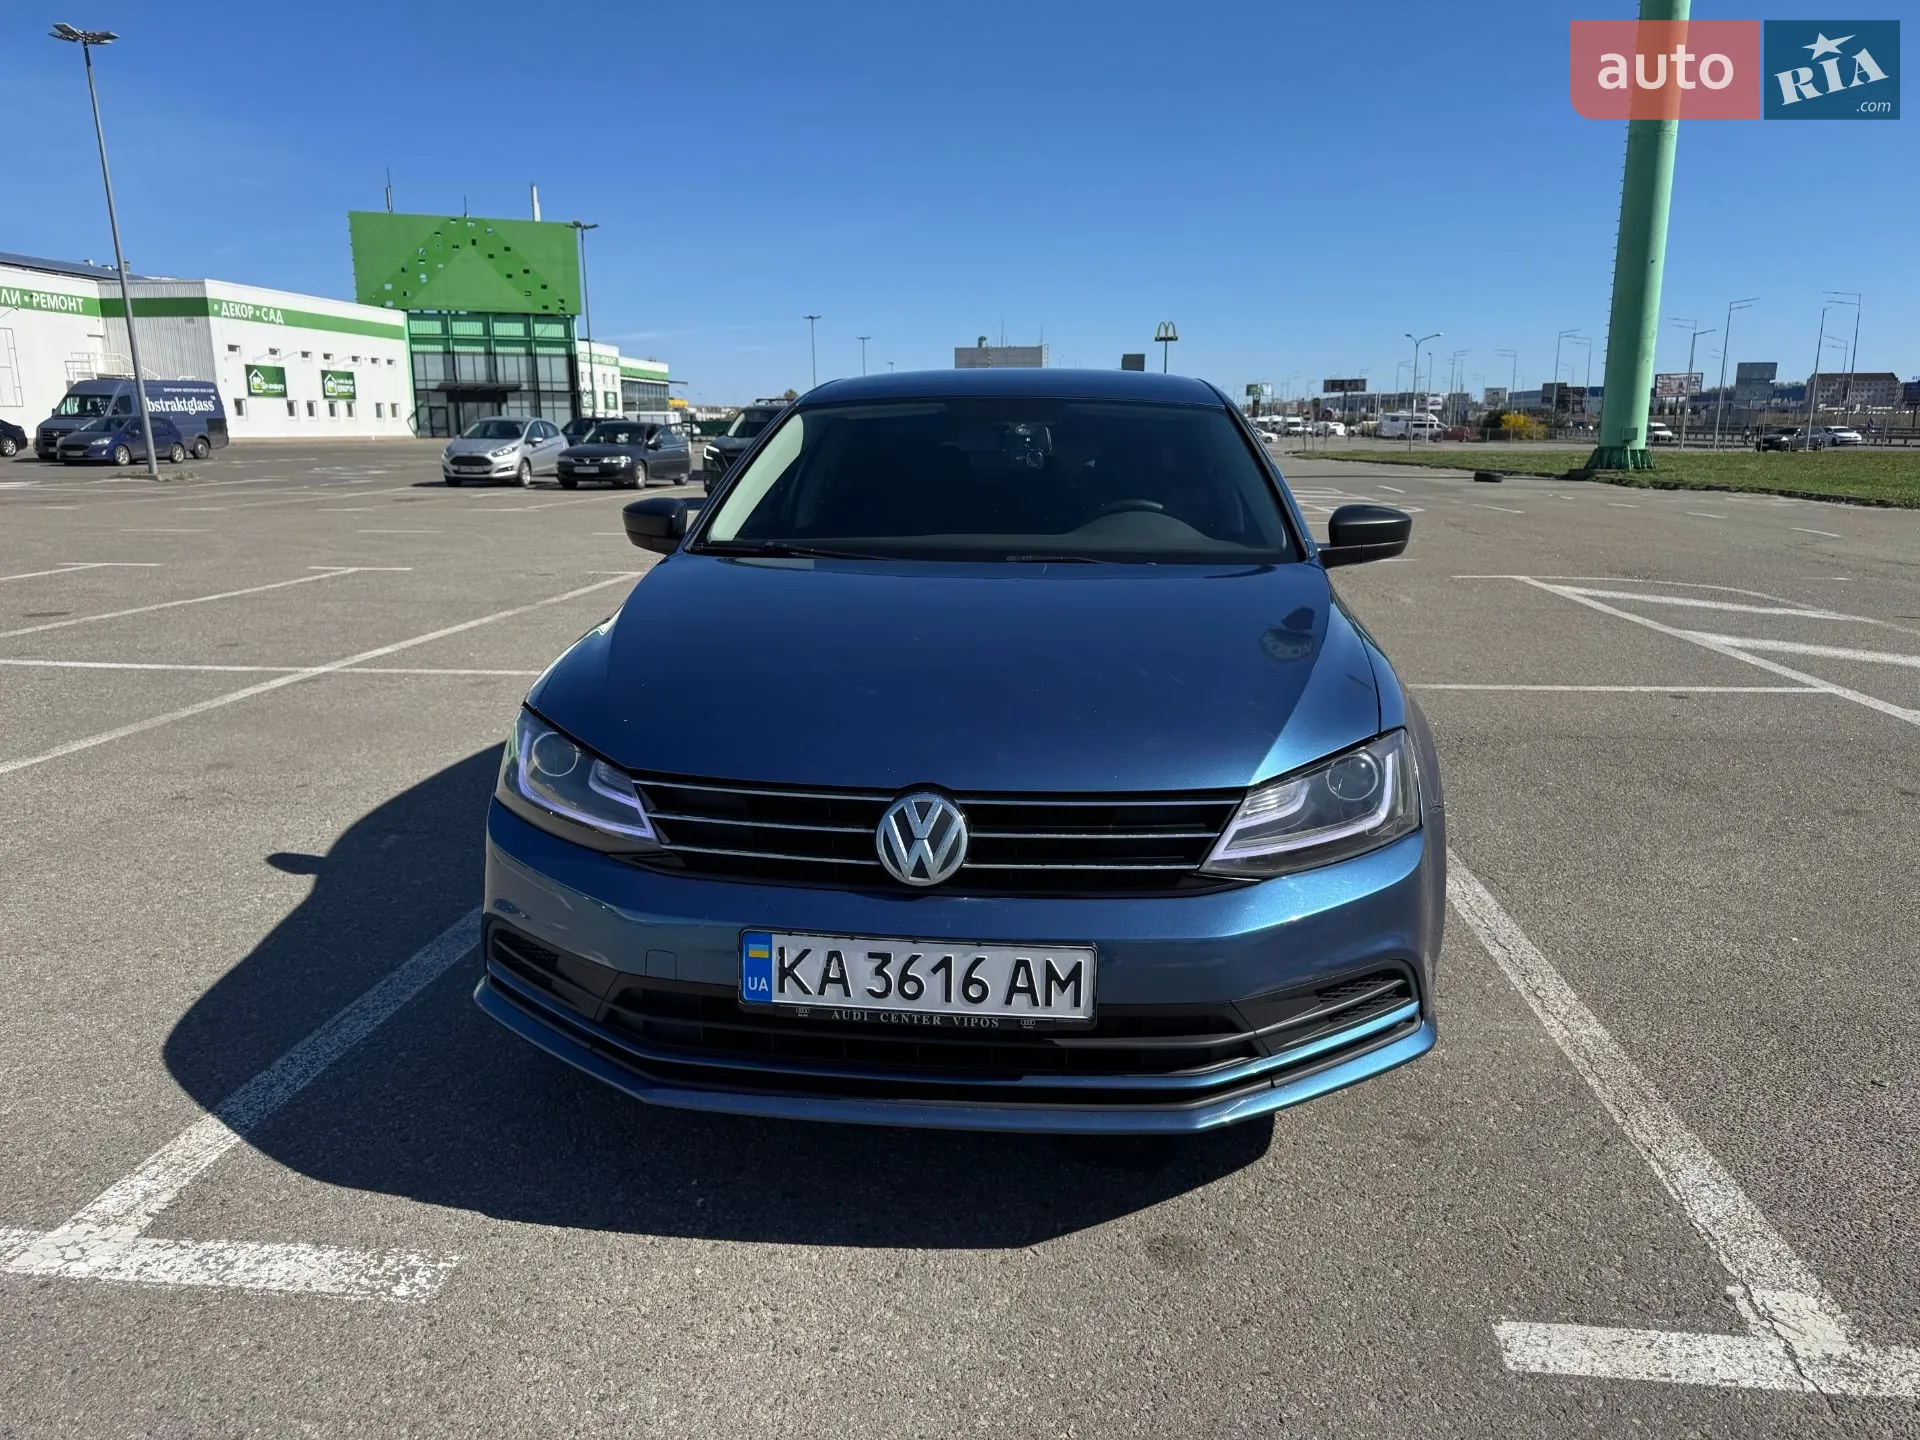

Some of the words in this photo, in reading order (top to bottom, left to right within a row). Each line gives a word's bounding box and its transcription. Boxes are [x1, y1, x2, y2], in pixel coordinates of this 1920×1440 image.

[32, 293, 84, 312] РЕМОНТ
[221, 302, 254, 319] ДЕКОР
[261, 307, 284, 325] САД
[145, 396, 215, 415] bstraktglass
[748, 976, 768, 992] UA
[777, 946, 853, 998] KA
[866, 951, 990, 1005] 3616
[1005, 957, 1084, 1010] AM
[831, 1010, 869, 1022] AUDI
[880, 1013, 942, 1026] CENTER
[952, 1016, 1000, 1029] VIPOS
